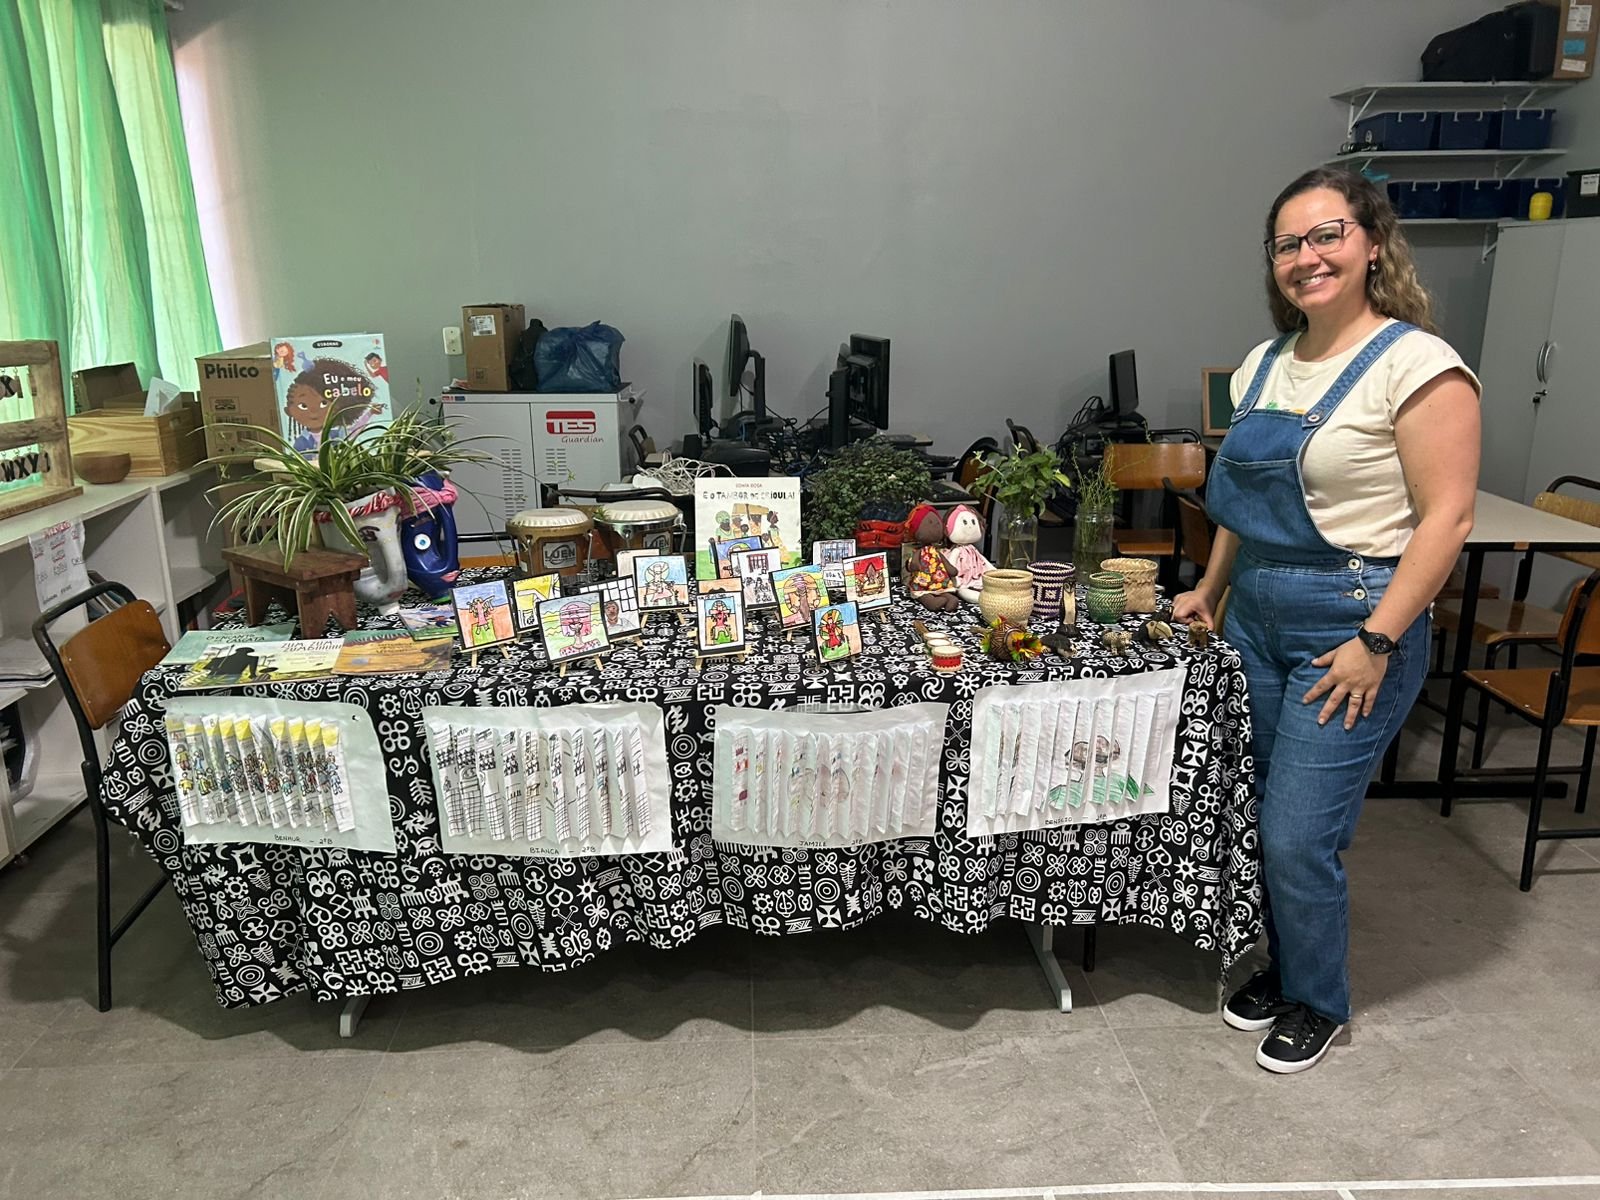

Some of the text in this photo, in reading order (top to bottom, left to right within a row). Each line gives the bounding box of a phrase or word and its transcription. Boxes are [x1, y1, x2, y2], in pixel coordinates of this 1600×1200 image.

[204, 363, 259, 379] Philco
[323, 373, 339, 385] Eu
[324, 383, 371, 399] cabelo
[546, 415, 597, 435] TES
[561, 436, 604, 444] Guardian
[716, 491, 749, 500] TAMBOR
[545, 548, 576, 559] LUEN
[529, 847, 560, 855] BIANCA
